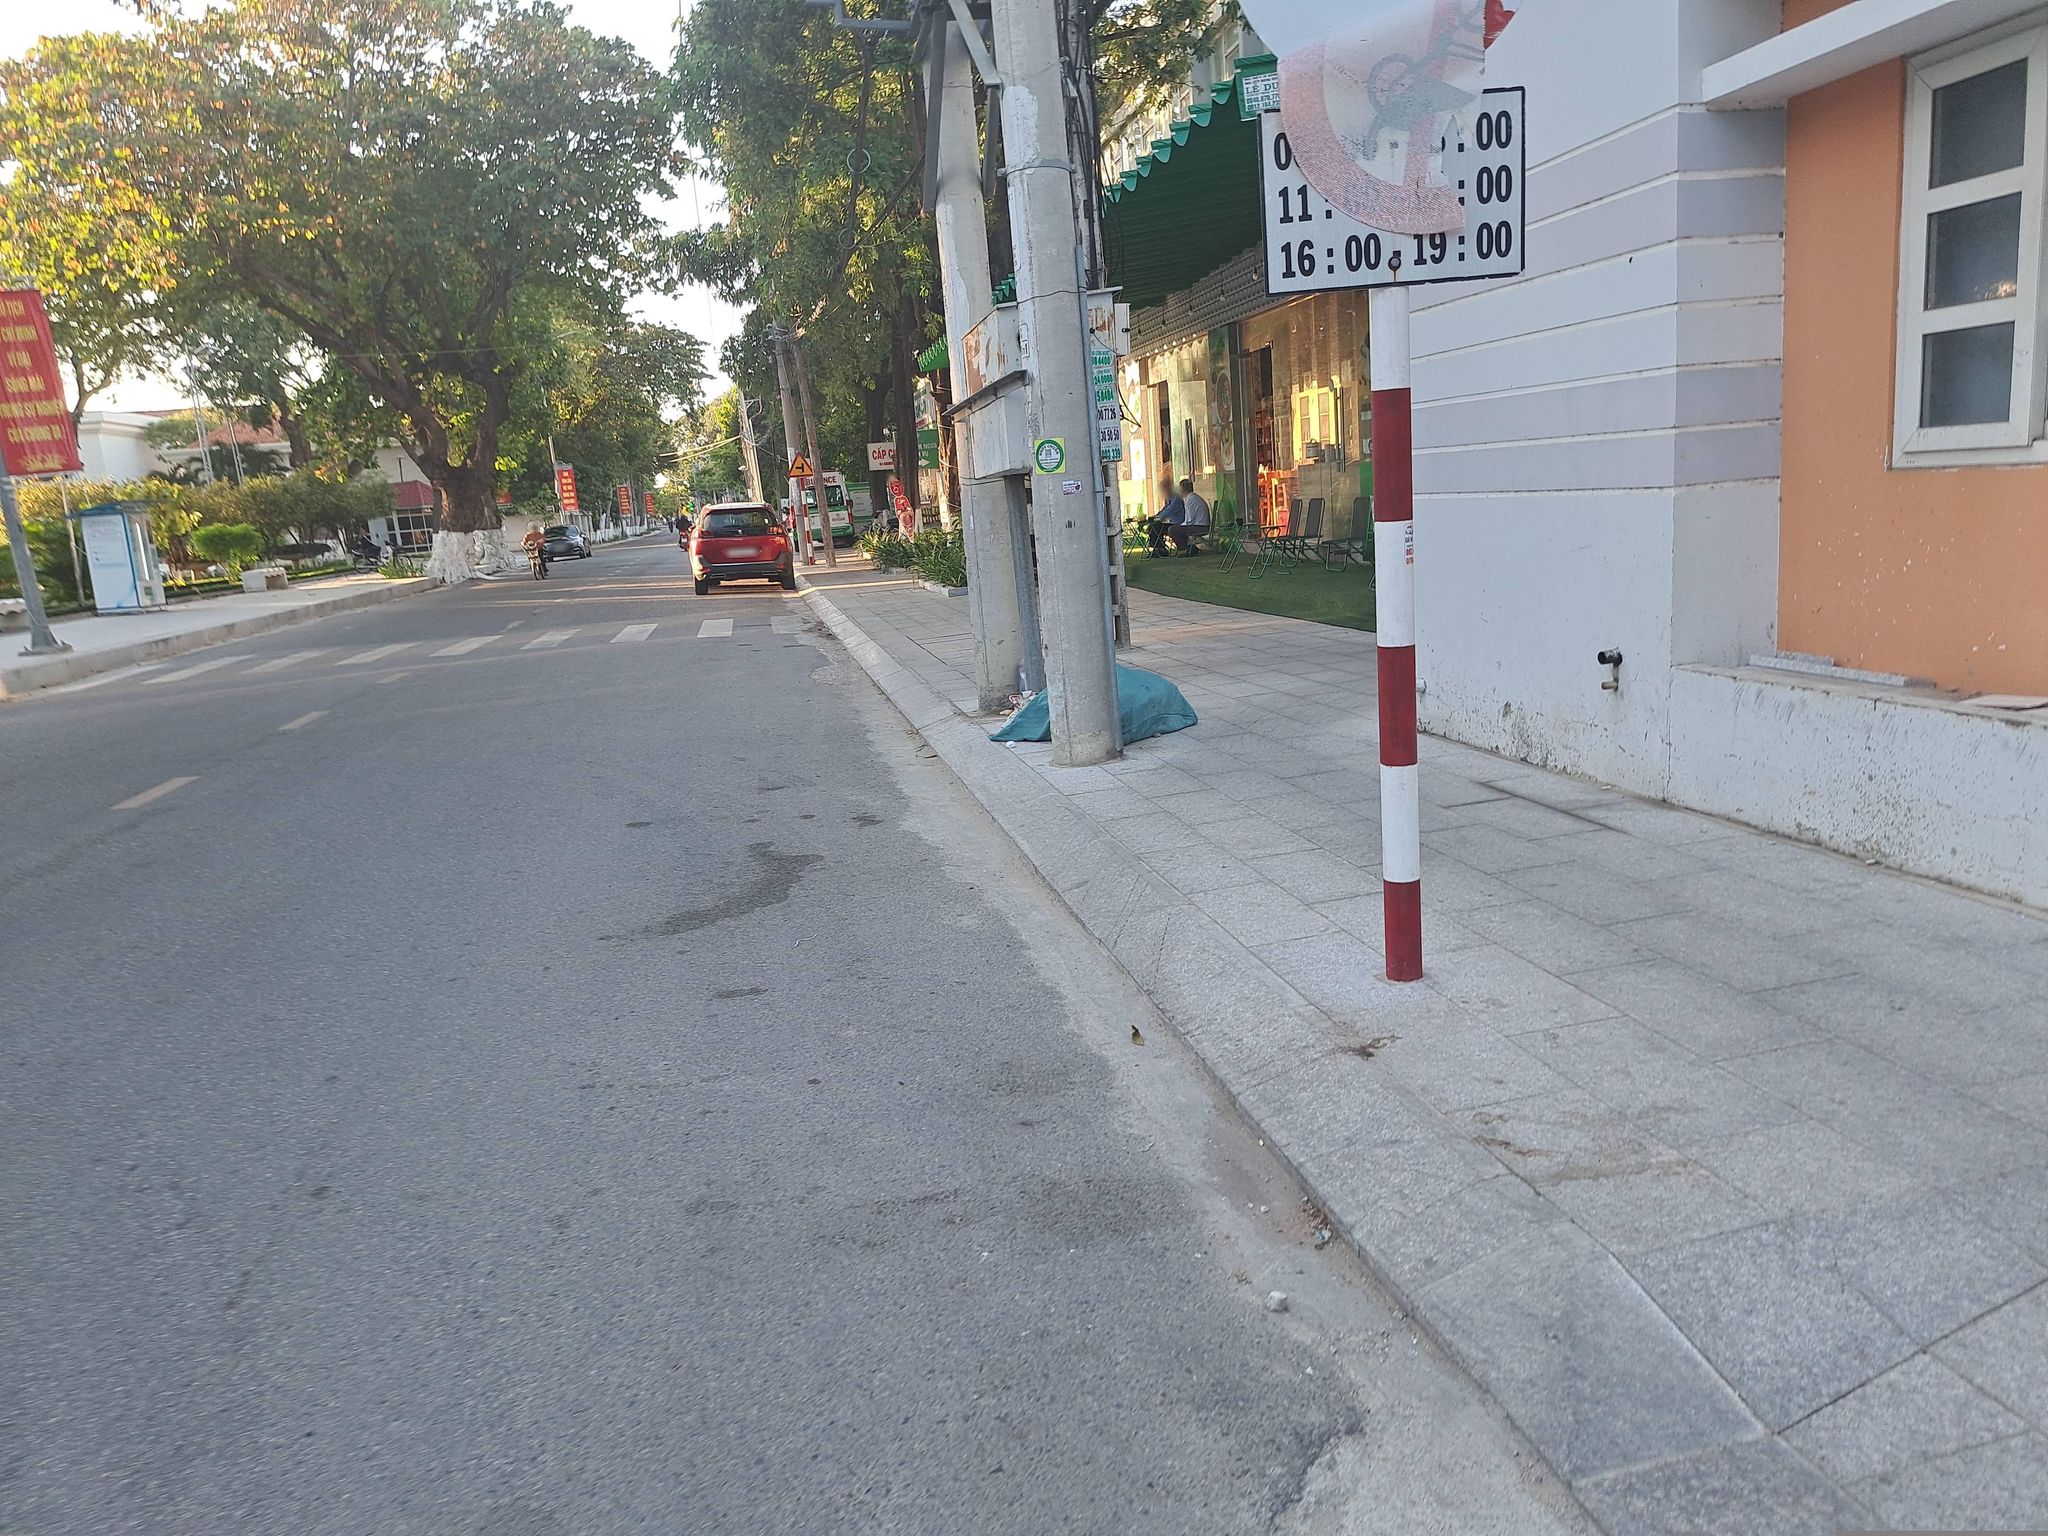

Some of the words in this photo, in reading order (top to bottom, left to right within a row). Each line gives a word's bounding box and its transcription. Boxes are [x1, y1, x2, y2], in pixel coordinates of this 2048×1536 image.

[1280, 233, 1382, 279] 16:00
[1413, 220, 1513, 266] 19:00
[872, 446, 887, 461] CẤP
